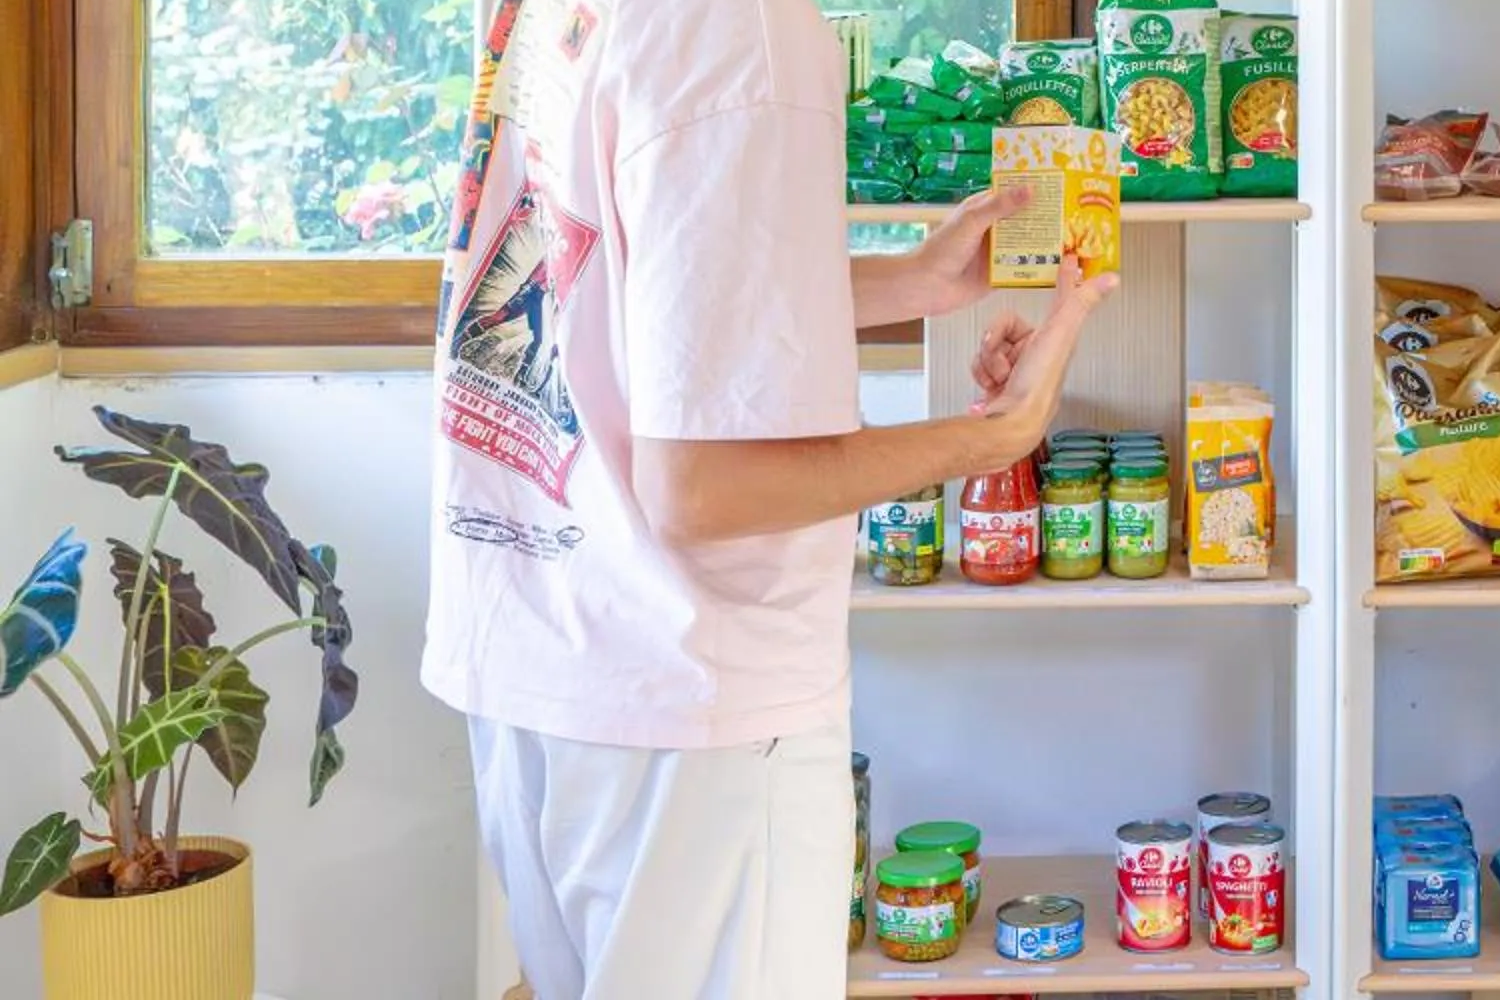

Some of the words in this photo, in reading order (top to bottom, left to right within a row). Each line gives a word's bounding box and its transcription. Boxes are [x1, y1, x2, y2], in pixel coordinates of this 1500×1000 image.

[1244, 62, 1297, 77] FUSILL
[1440, 423, 1489, 437] nature
[1131, 877, 1173, 888] RAVIOLI
[1215, 880, 1269, 893] SPAGHETTI
